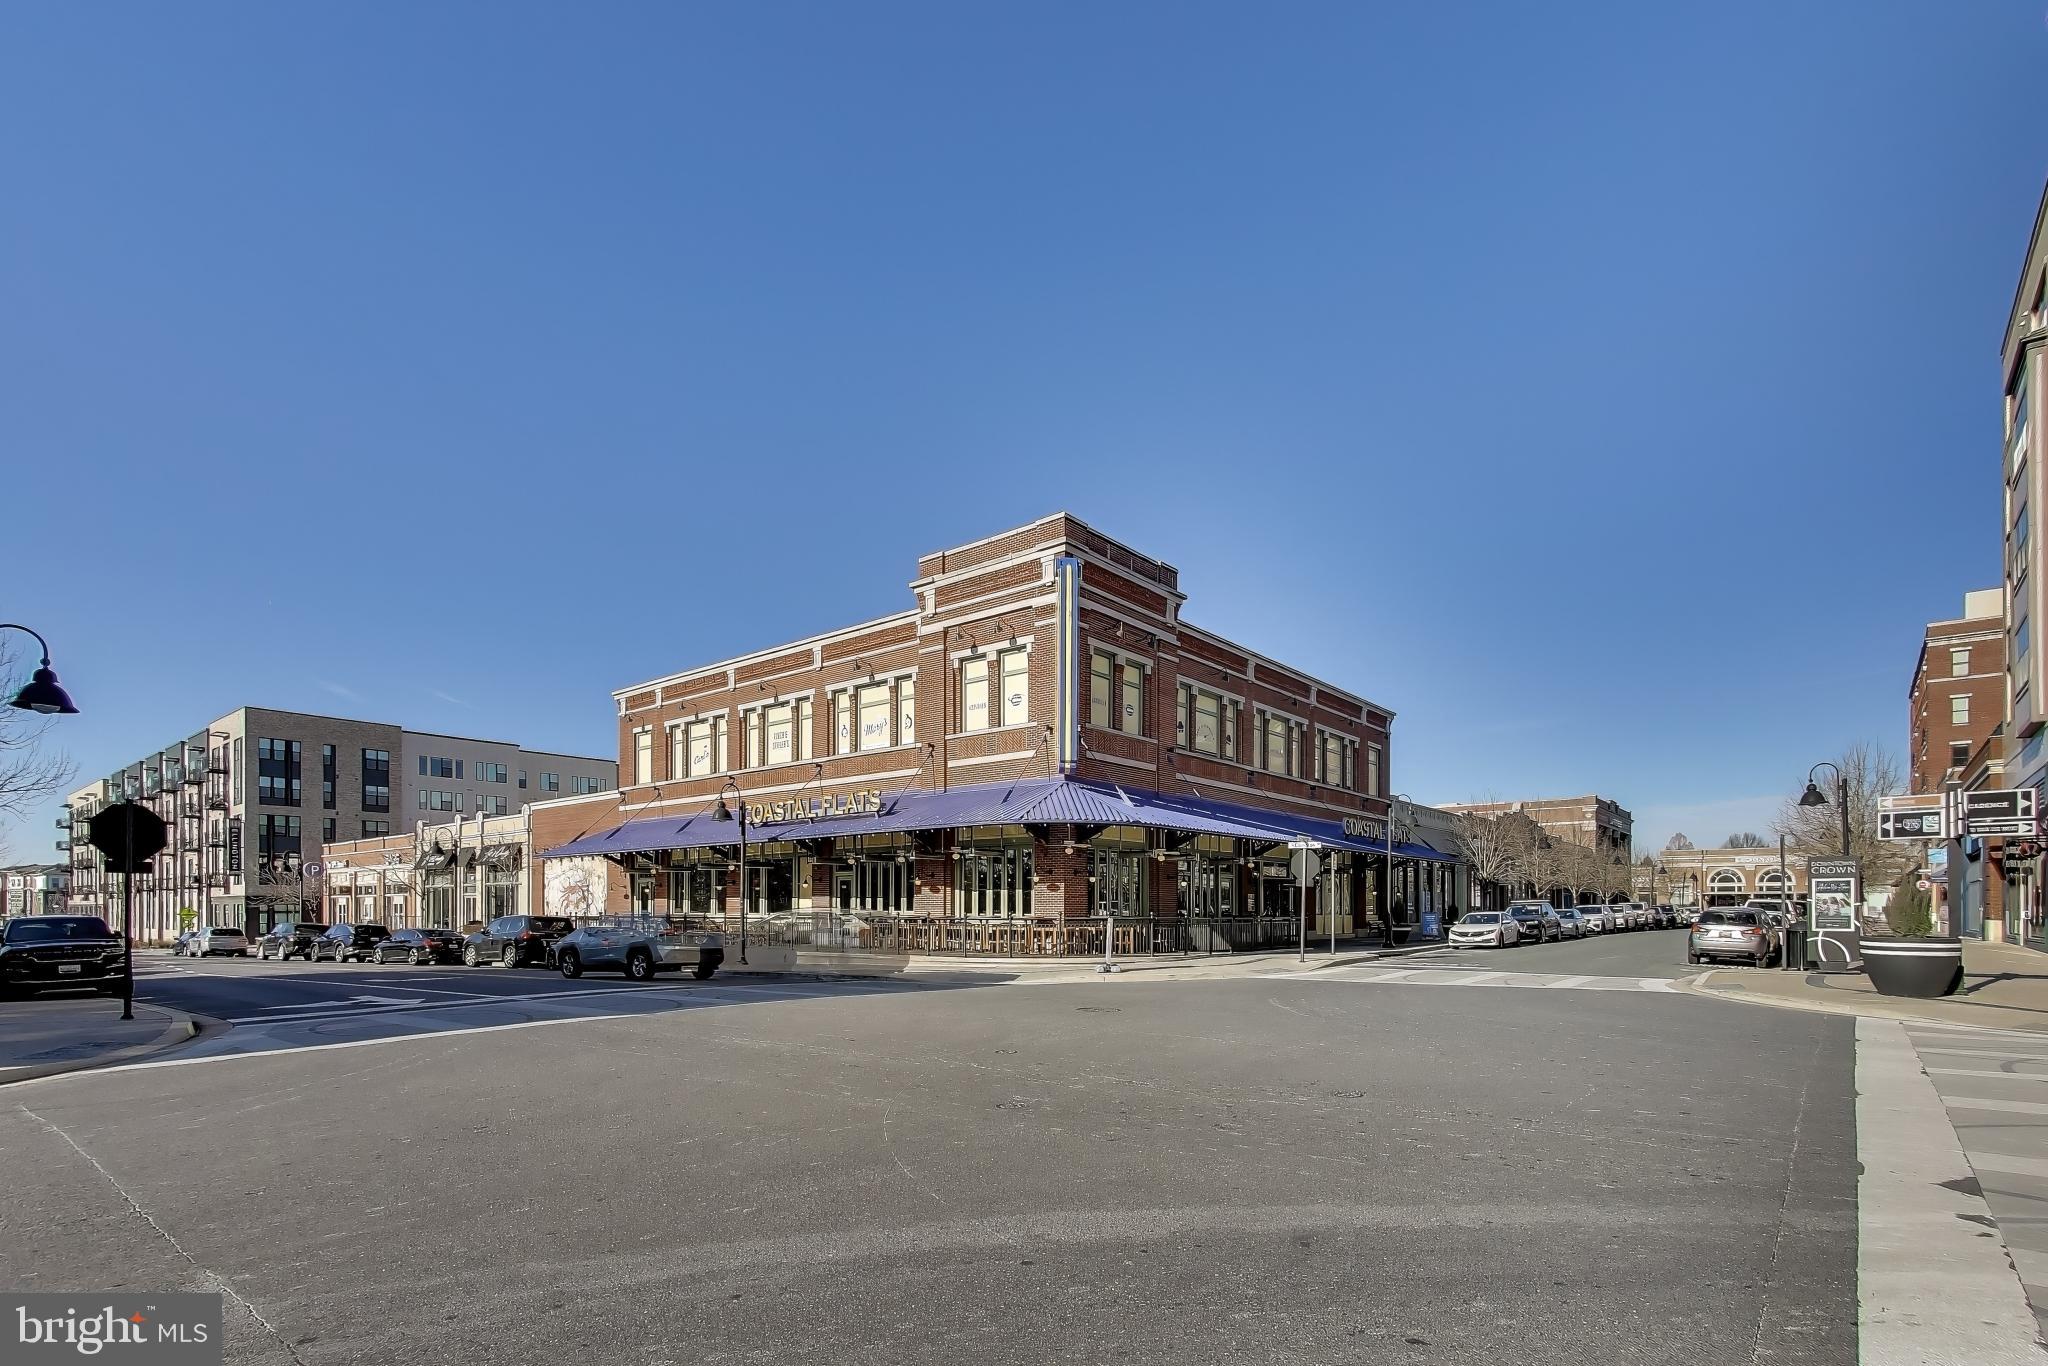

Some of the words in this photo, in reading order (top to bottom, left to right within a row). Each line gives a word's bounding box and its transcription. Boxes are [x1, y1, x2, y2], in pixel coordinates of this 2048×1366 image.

[821, 789, 882, 818] FLATS
[1343, 816, 1386, 840] COASTAL
[311, 865, 320, 876] P
[1811, 866, 1856, 874] CROWN
